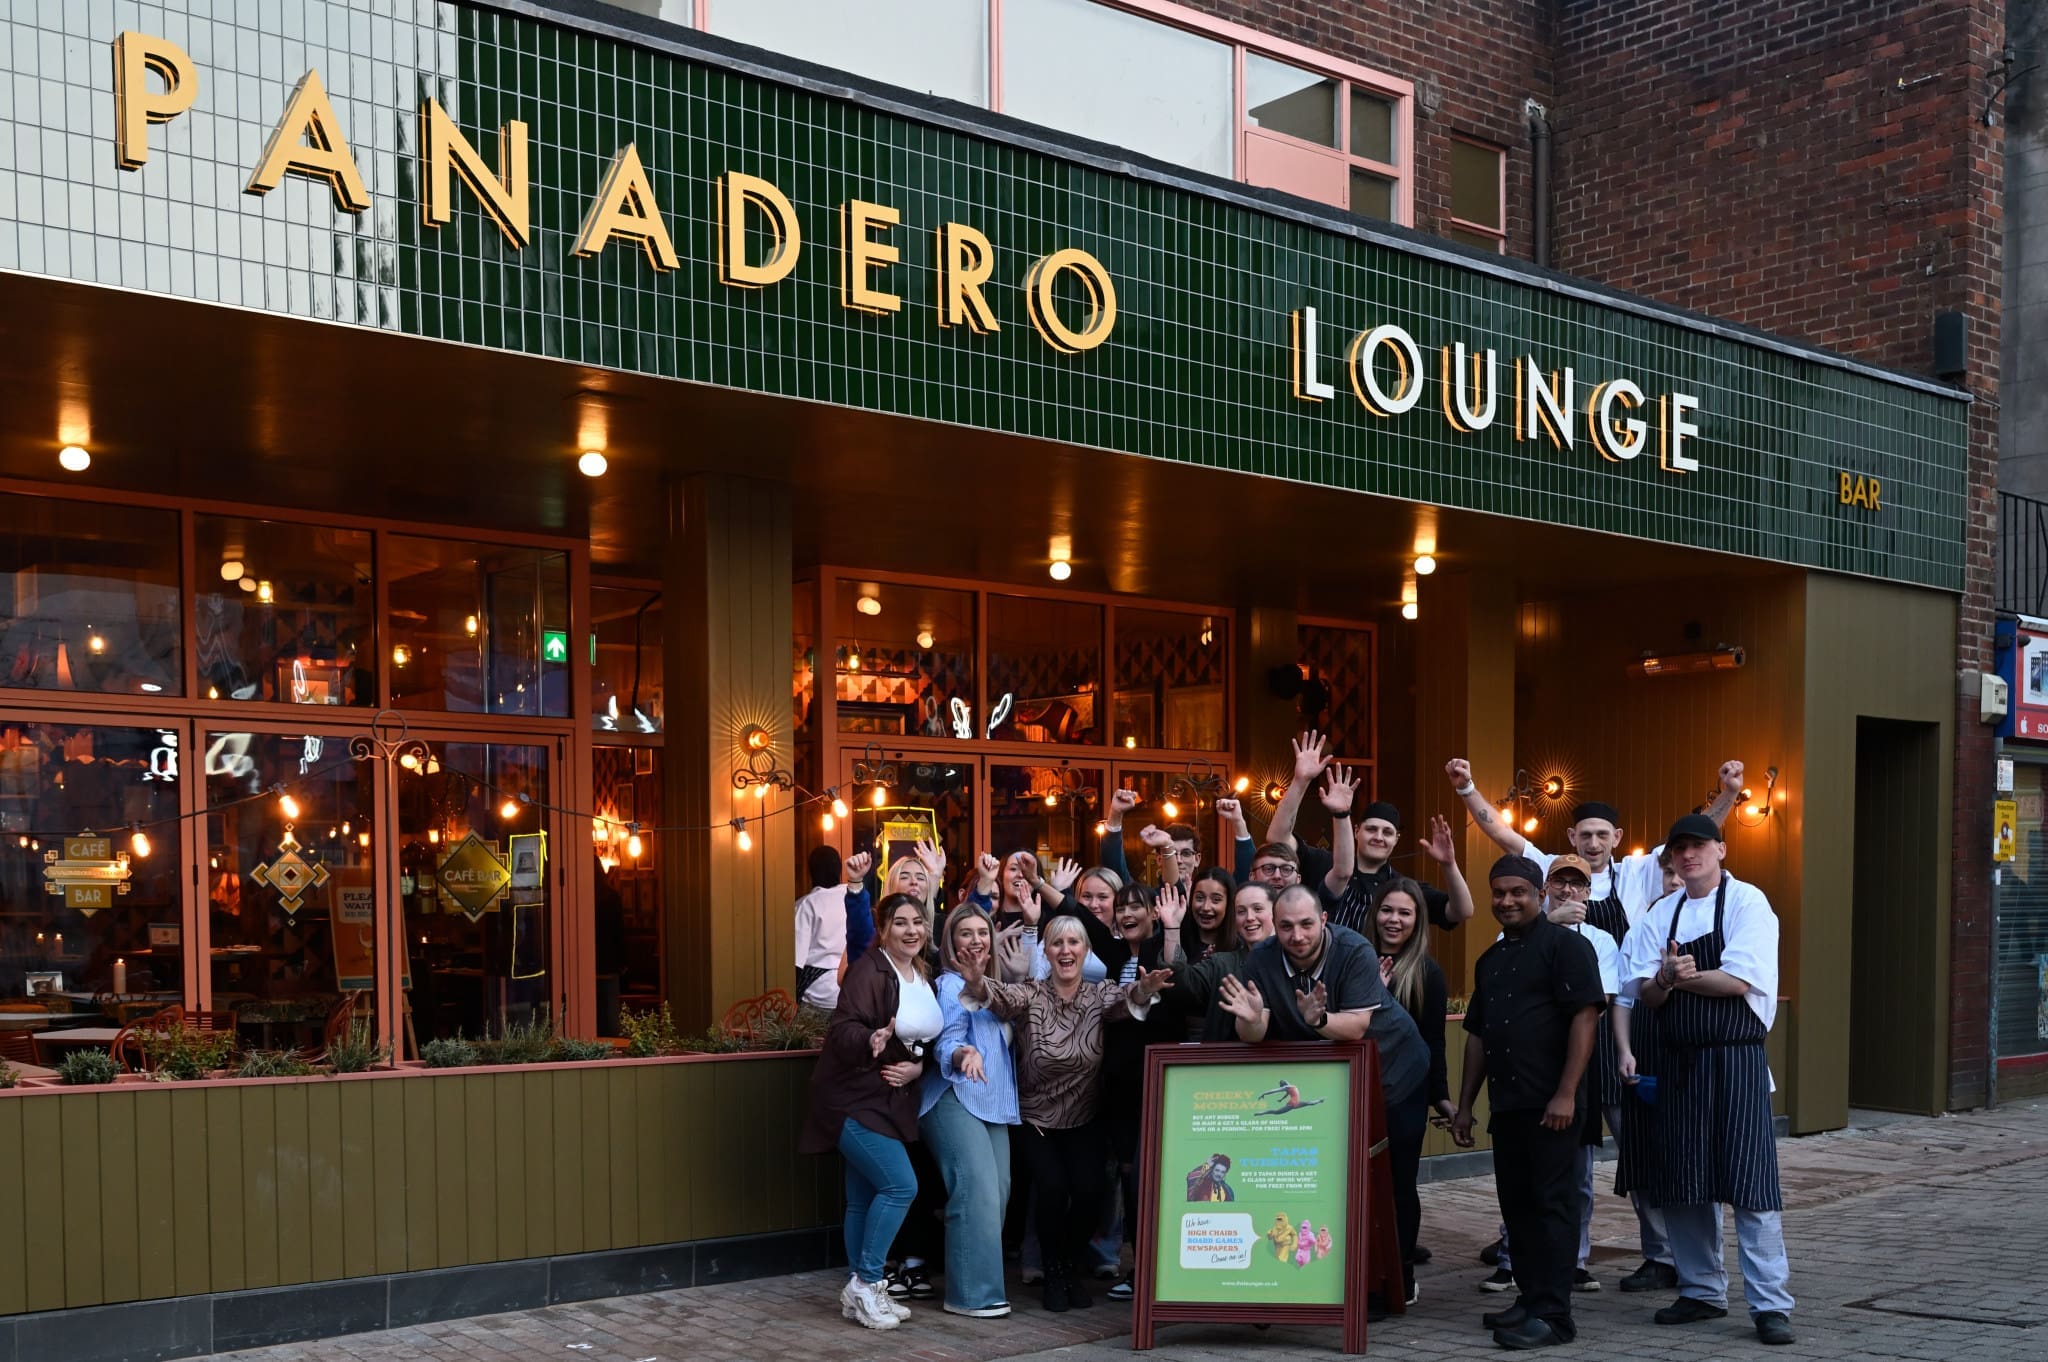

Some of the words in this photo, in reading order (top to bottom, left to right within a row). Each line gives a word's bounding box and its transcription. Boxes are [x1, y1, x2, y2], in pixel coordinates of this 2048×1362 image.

[113, 30, 1117, 353] PANADERO
[1292, 306, 1699, 473] LOUNGE
[1839, 471, 1881, 511] BAR
[70, 840, 106, 857] CAFÉ
[444, 867, 475, 881] CAFÉ
[477, 870, 502, 882] BAR
[75, 889, 102, 902] BAR
[343, 902, 373, 910] WAIT
[1193, 1090, 1254, 1100] CHEEKY
[1193, 1101, 1268, 1111] MONDAYS
[1271, 1147, 1318, 1156] TAPAS
[1240, 1157, 1318, 1167] TUESDAYS
